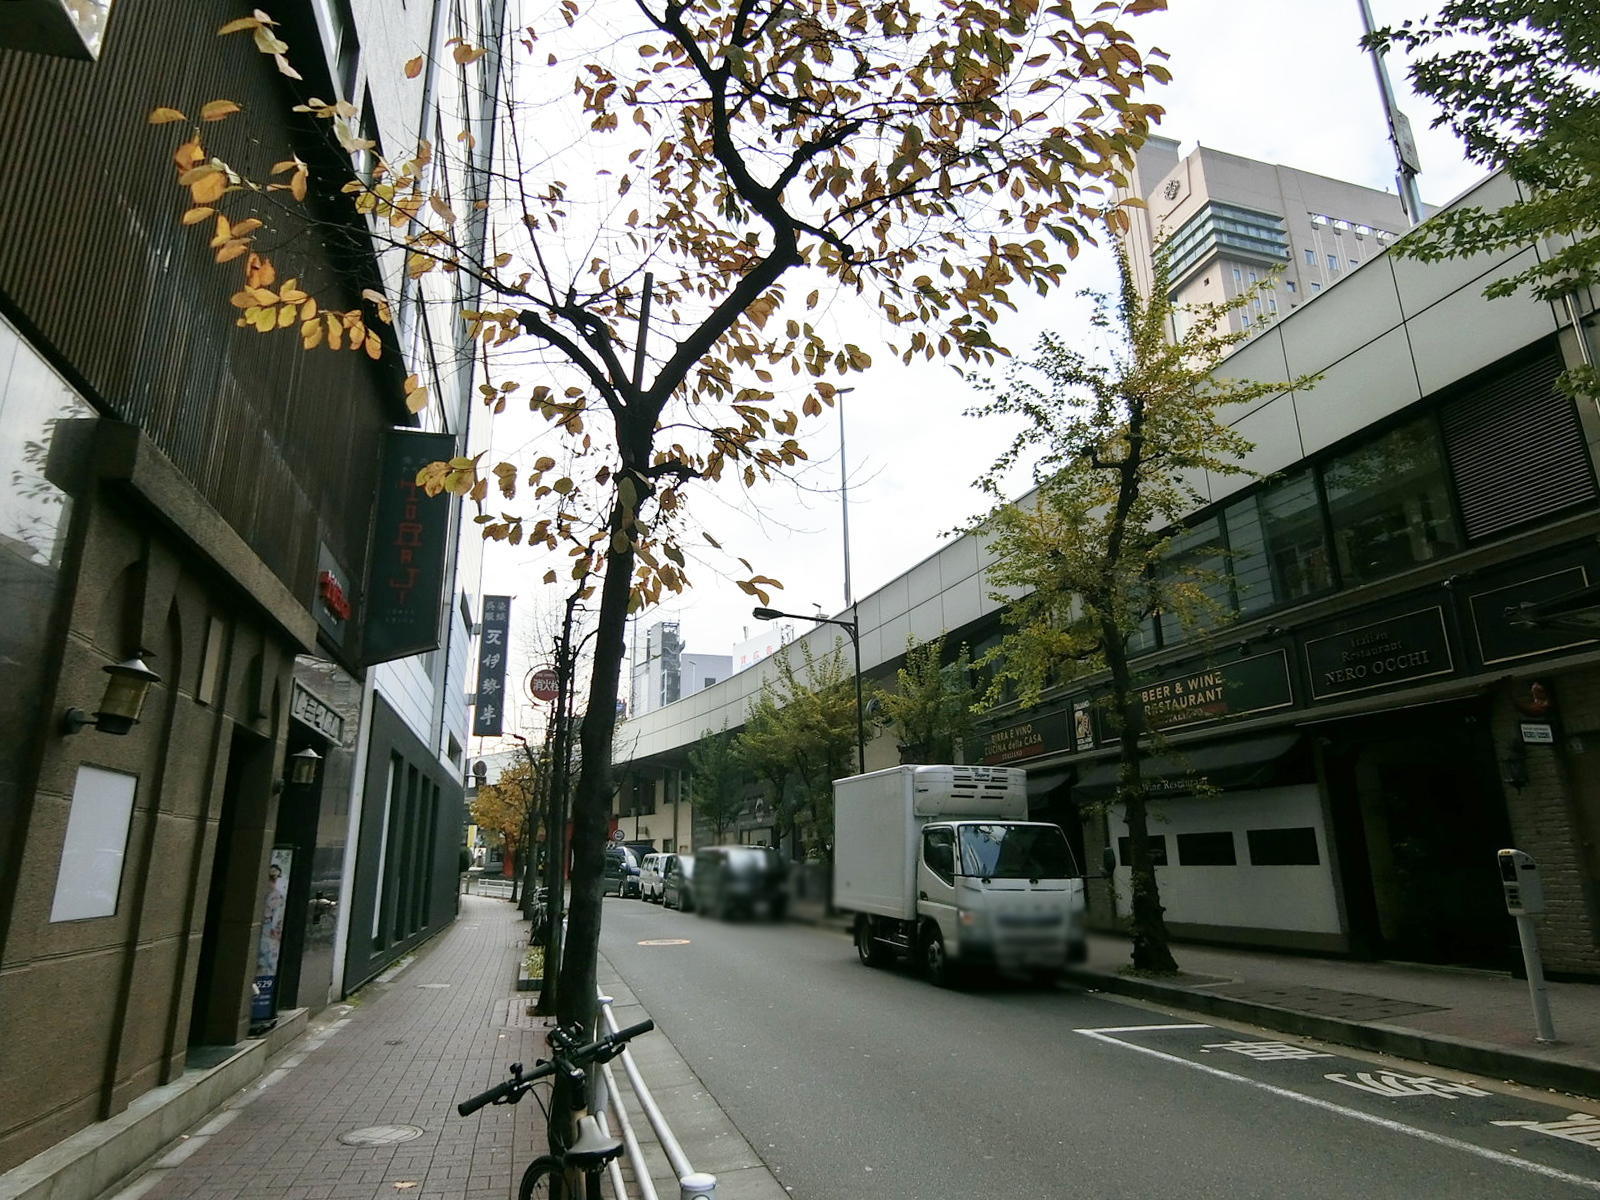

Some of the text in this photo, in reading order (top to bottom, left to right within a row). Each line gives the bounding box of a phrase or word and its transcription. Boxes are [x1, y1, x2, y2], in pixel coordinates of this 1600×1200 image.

[1324, 650, 1431, 686] NERO OCCHI
[533, 679, 559, 692] 消火栓
[1141, 671, 1222, 703] BEER & WINE
[1015, 724, 1032, 736] VINO
[984, 743, 1007, 756] CUCINA
[1024, 734, 1043, 746] CASA
